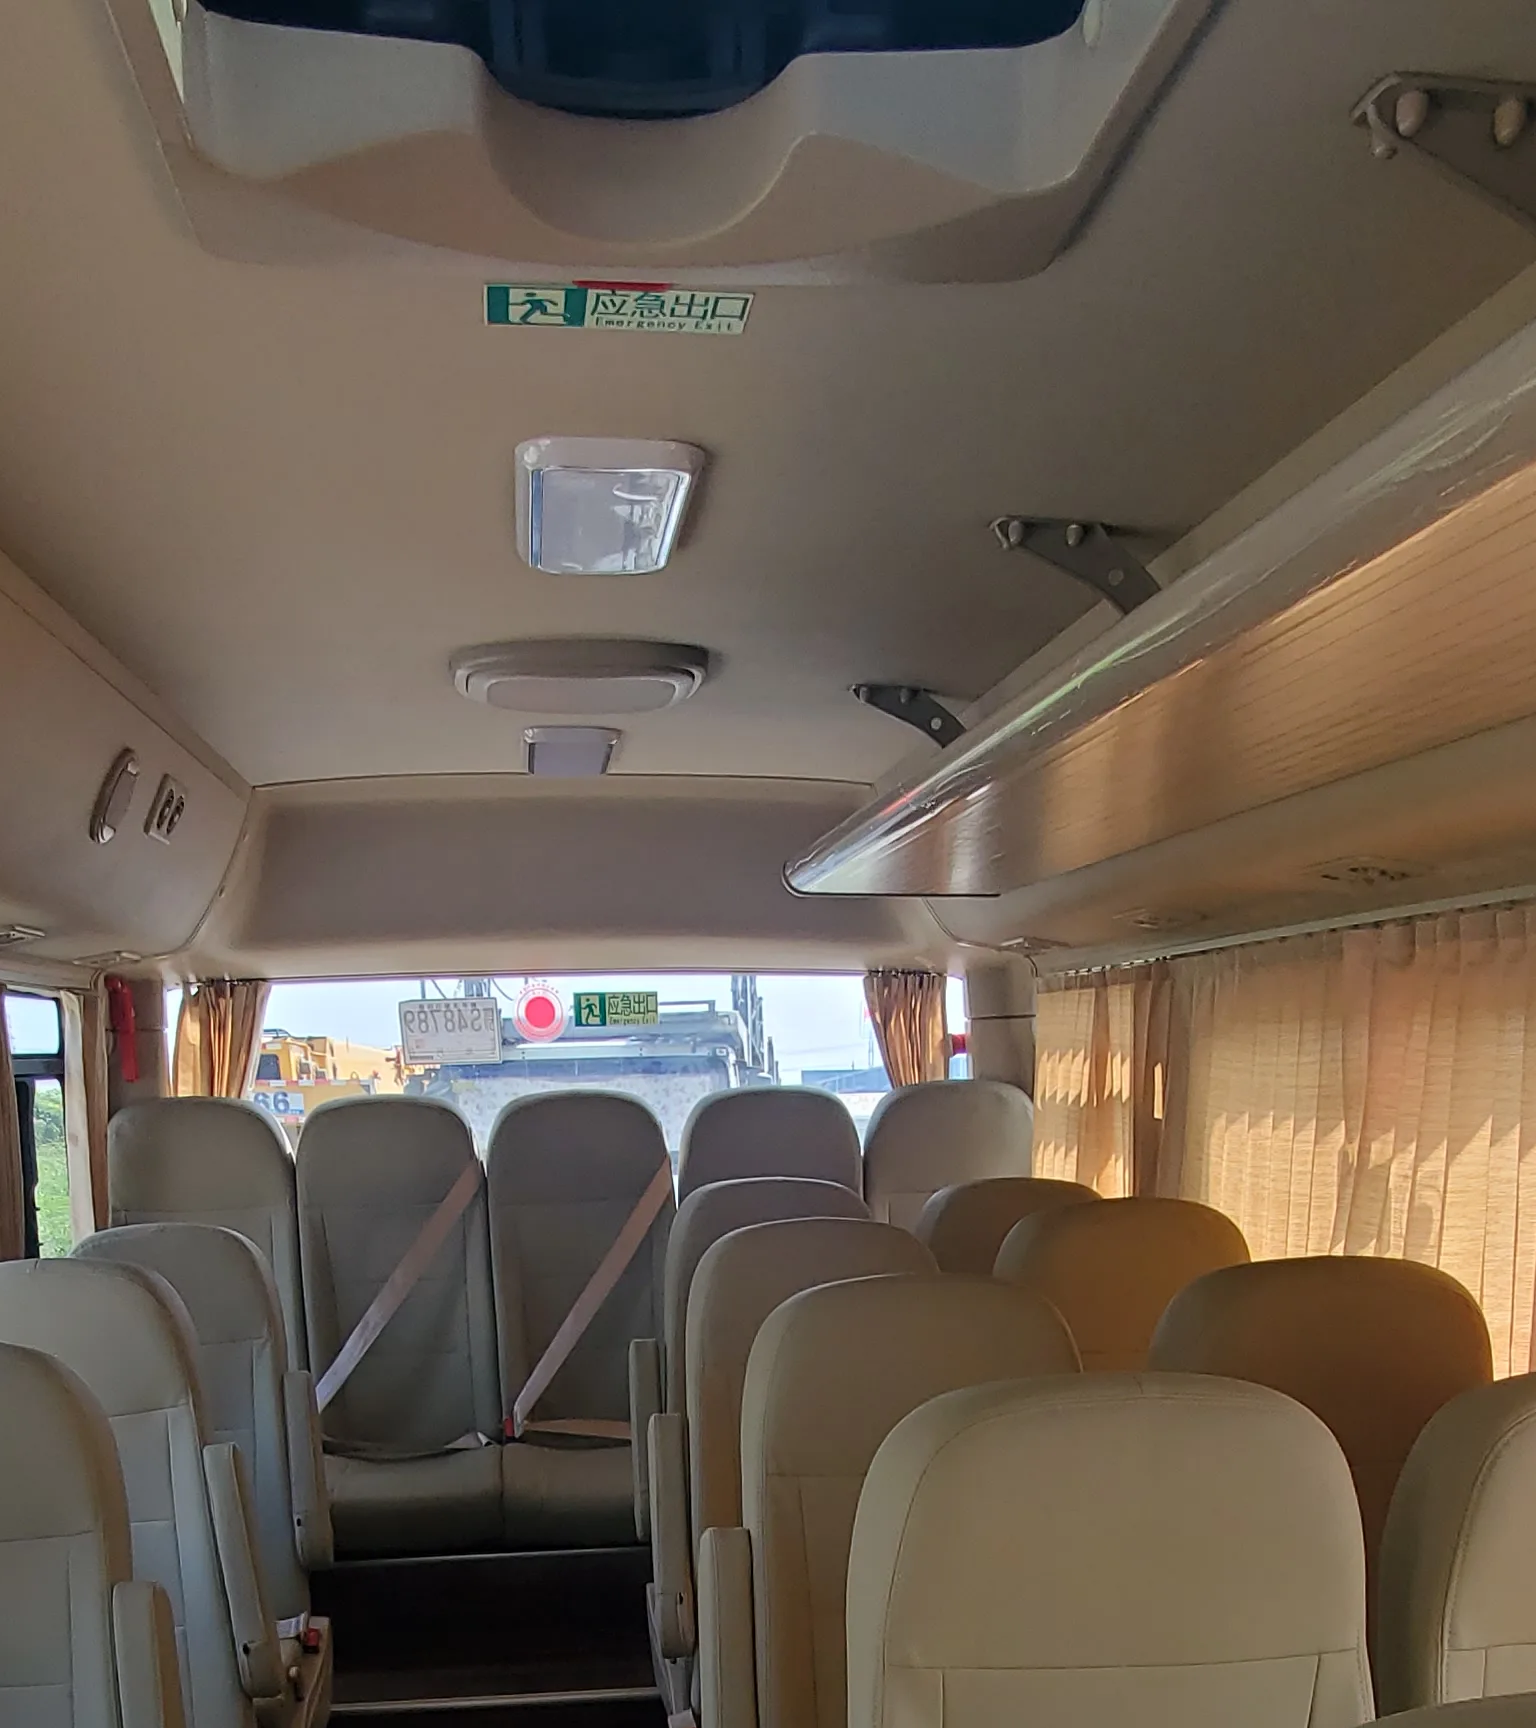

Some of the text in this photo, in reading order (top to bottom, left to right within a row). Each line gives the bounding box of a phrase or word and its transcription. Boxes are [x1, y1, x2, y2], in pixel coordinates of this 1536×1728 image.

[591, 290, 750, 321] 应急出口
[595, 317, 735, 331] Emergency Exit
[607, 994, 658, 1016] 应急出口
